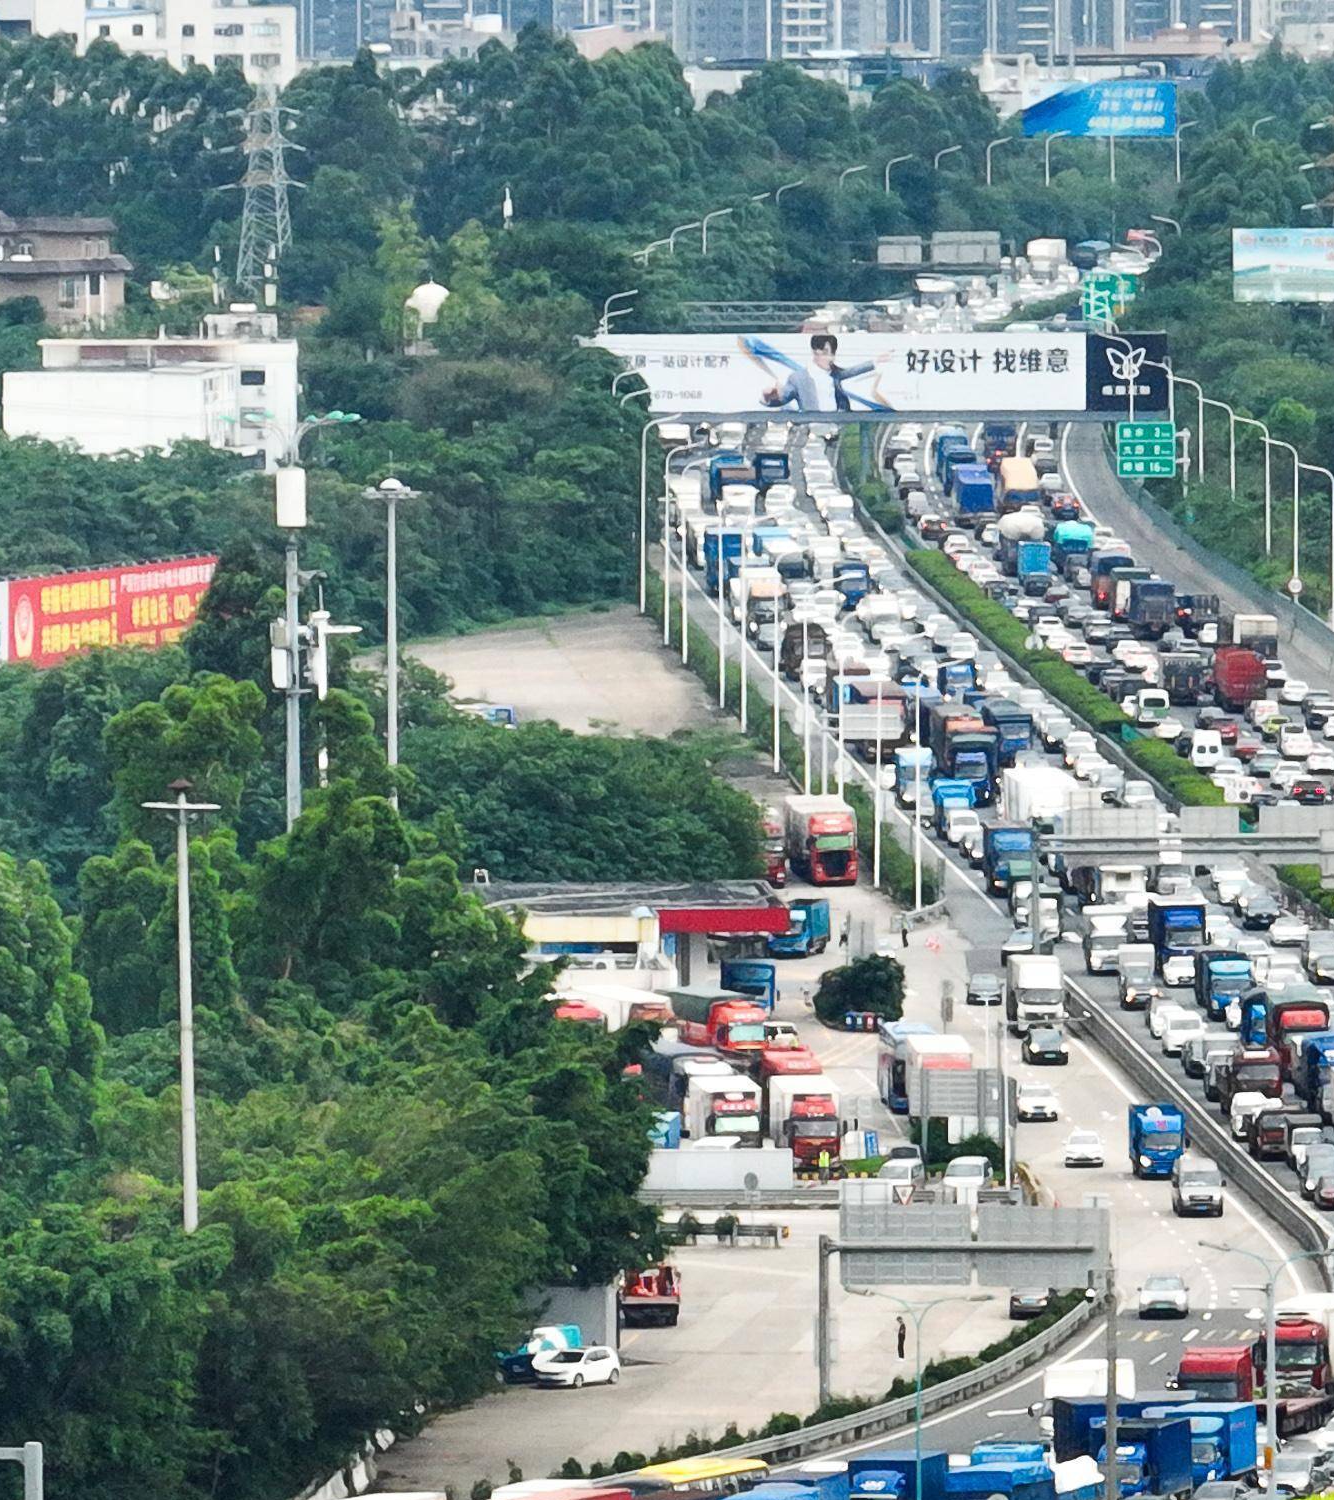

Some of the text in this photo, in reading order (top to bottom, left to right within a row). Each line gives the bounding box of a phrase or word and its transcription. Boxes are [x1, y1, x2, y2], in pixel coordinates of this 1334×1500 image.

[907, 347, 1069, 374] 好设计 找维意
